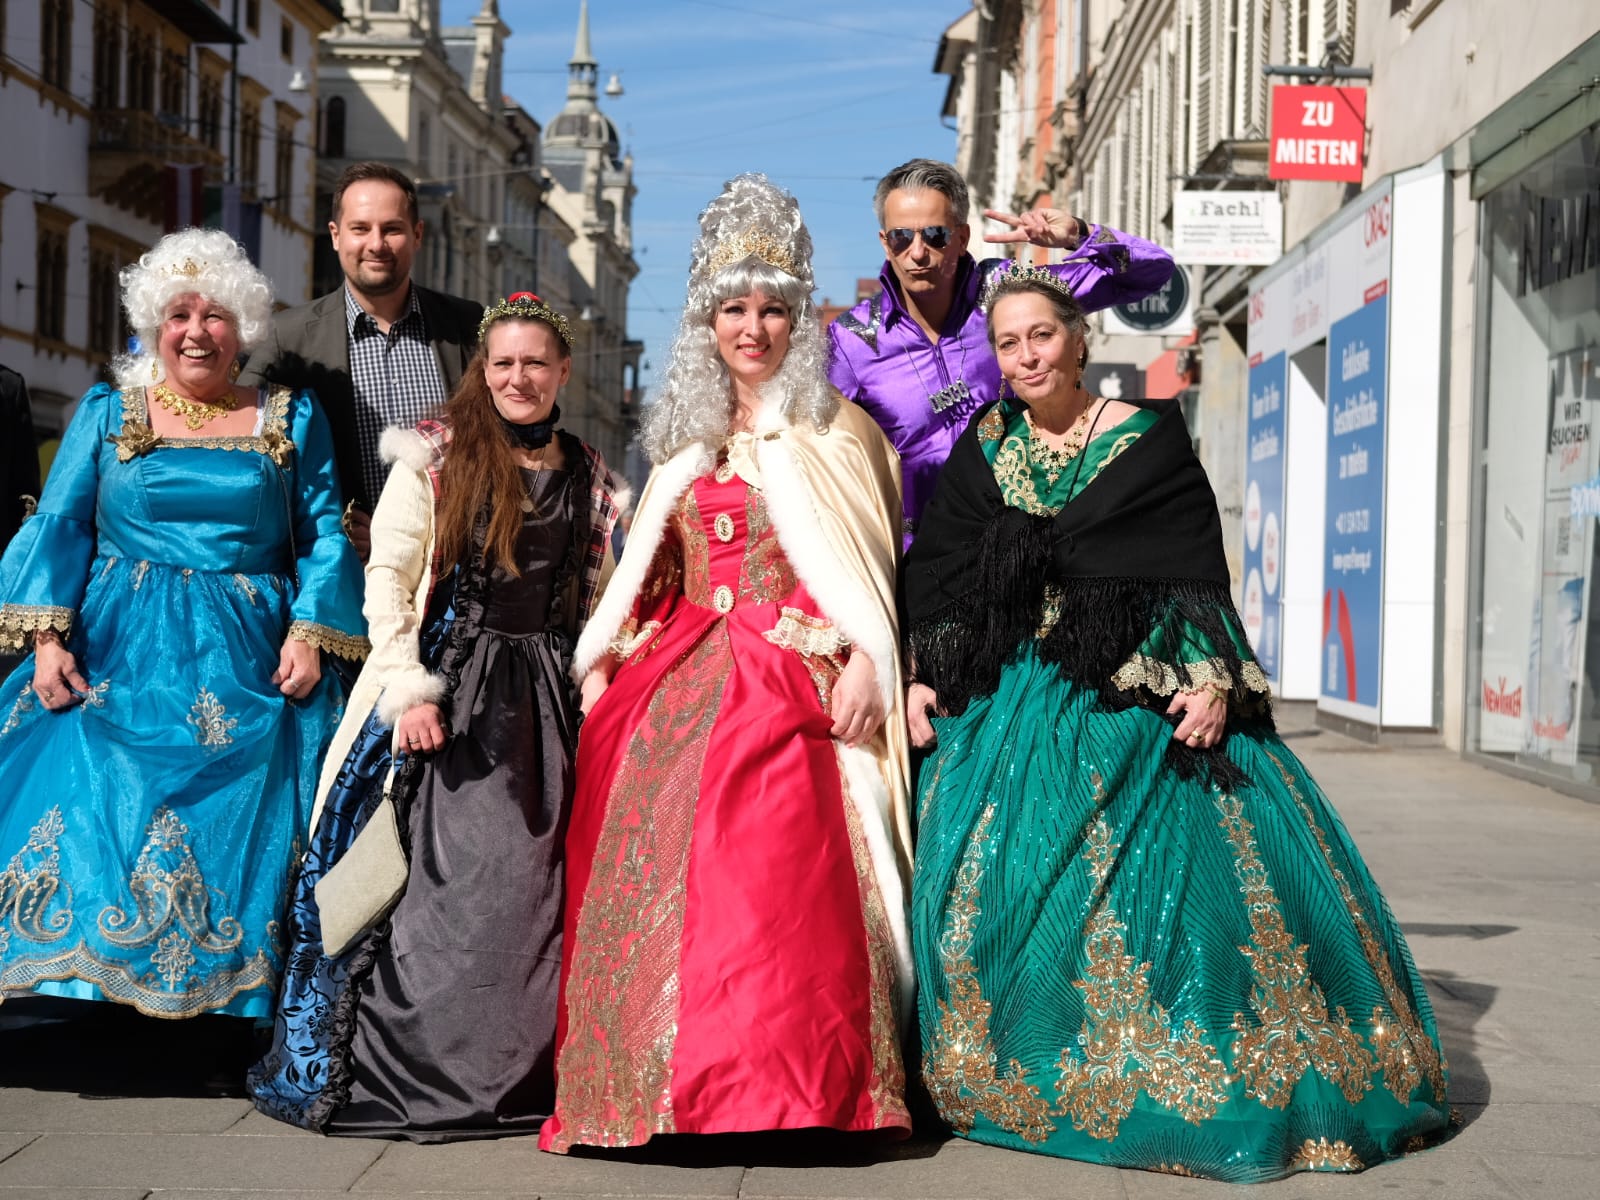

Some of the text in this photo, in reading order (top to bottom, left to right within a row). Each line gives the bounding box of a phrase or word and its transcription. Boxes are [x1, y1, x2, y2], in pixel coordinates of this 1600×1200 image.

[1301, 101, 1334, 127] ZU
[1275, 138, 1358, 166] MIETEN
[1200, 201, 1260, 216] Fachl
[1564, 402, 1582, 421] WIR
[1552, 424, 1591, 446] SUCHEN
